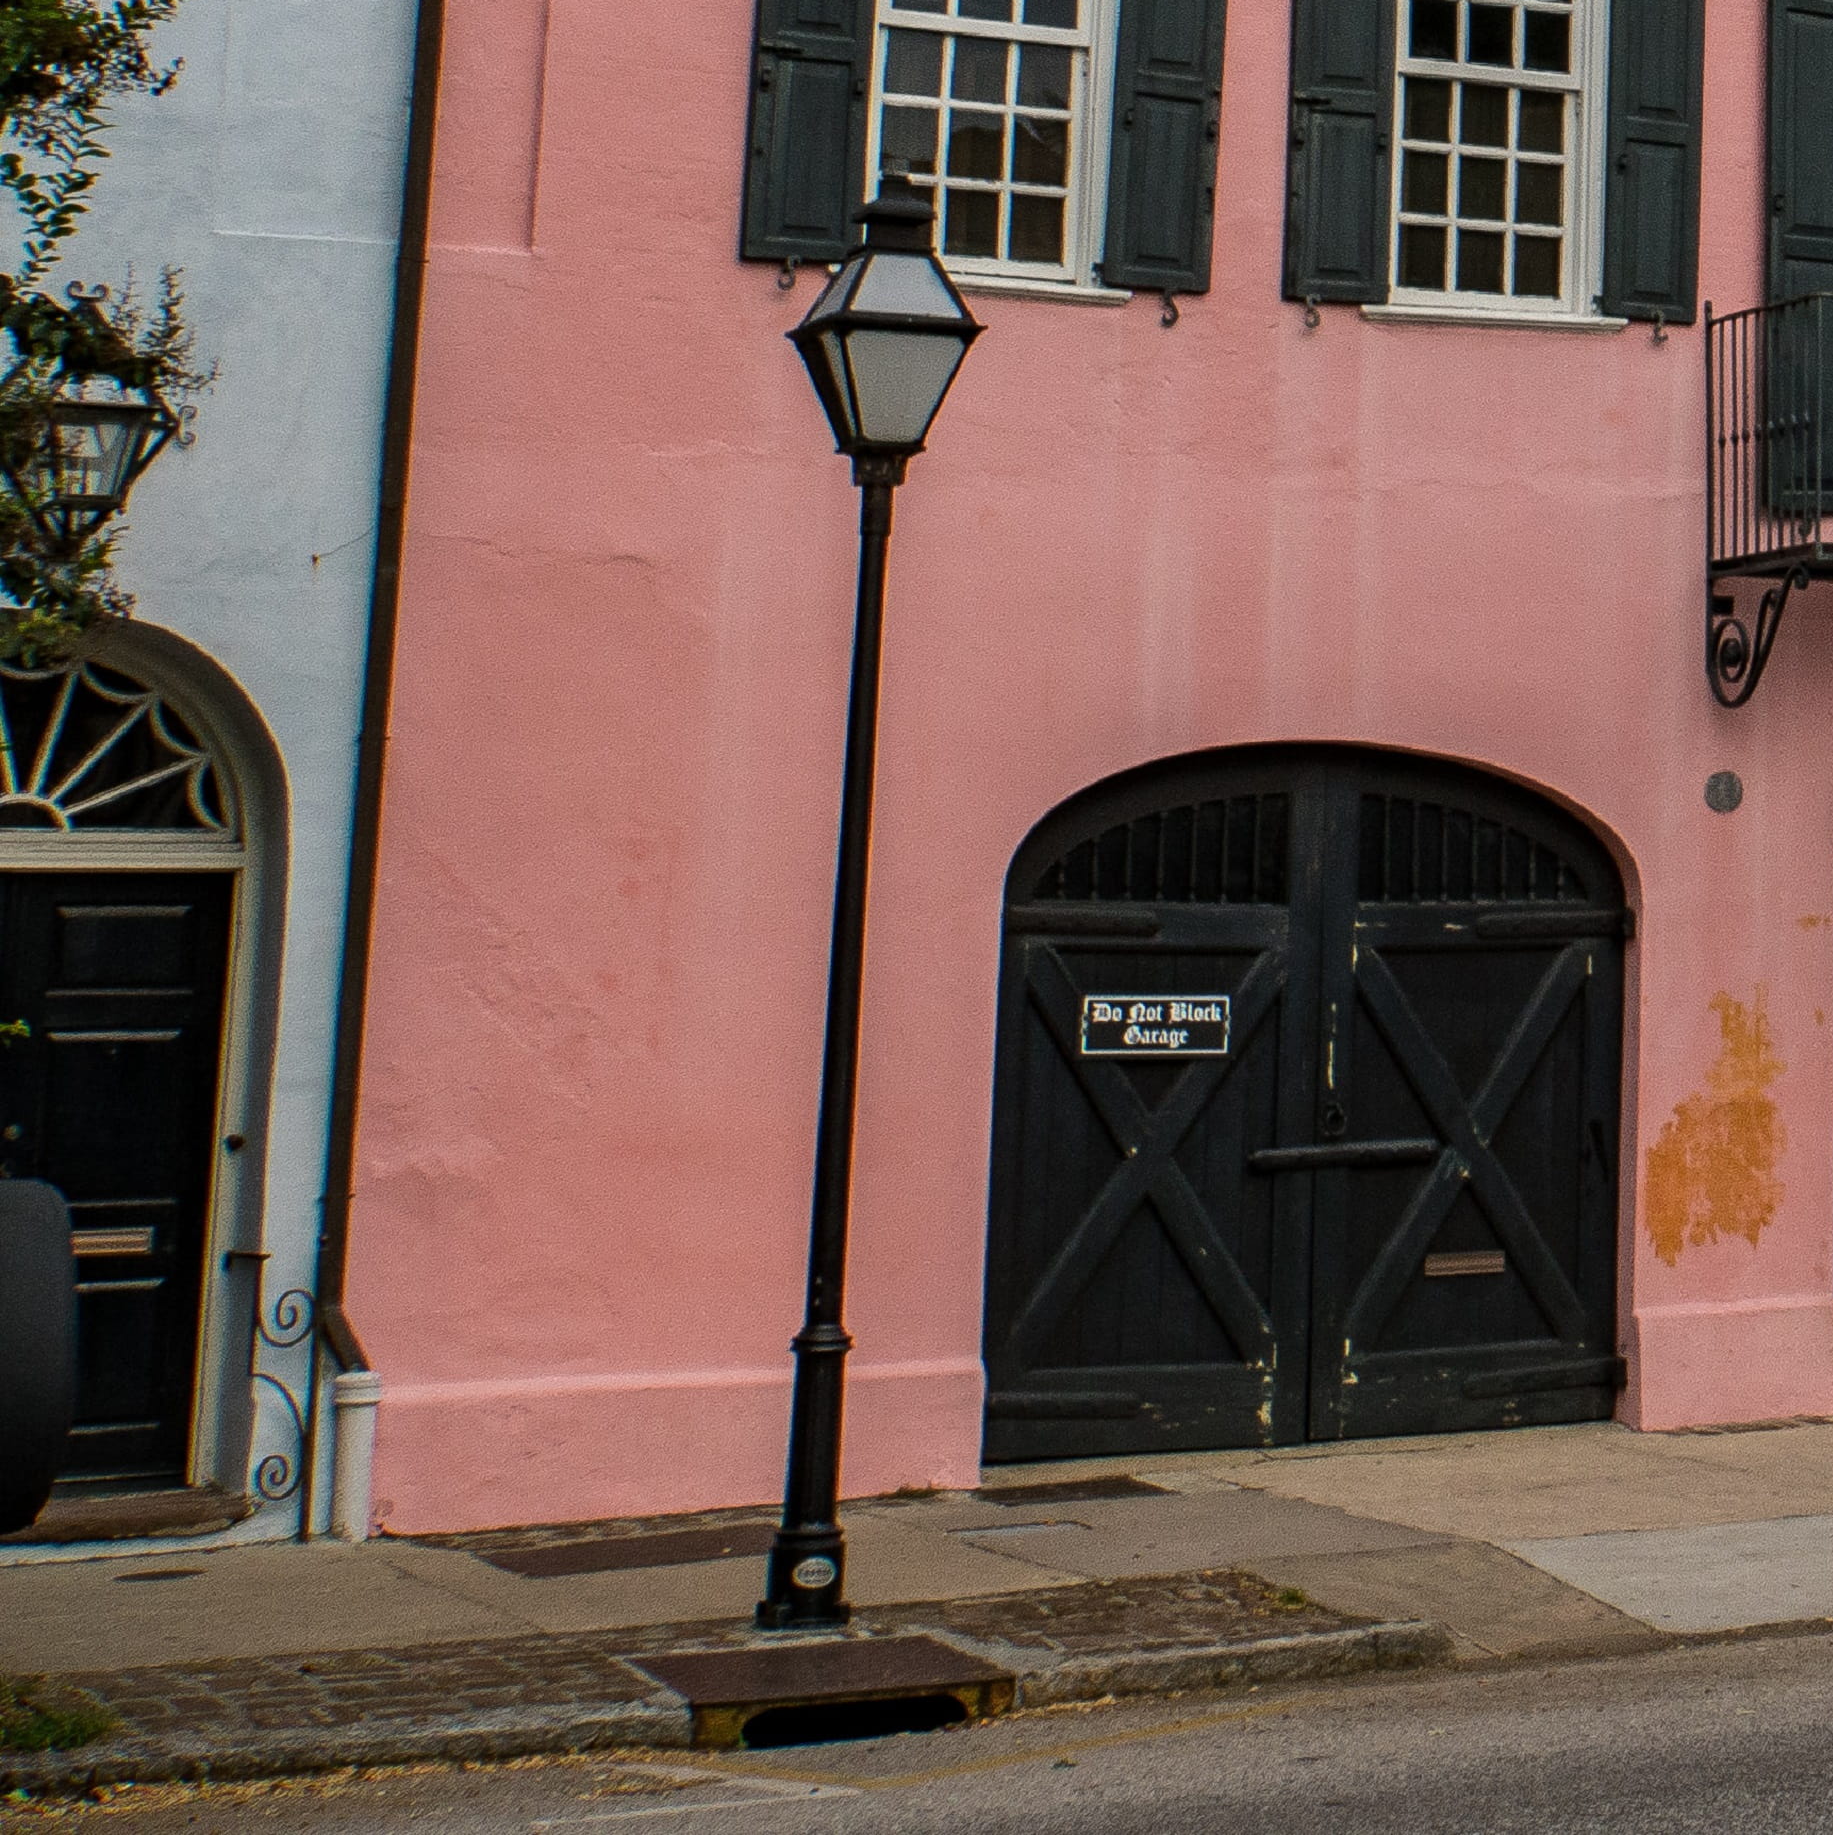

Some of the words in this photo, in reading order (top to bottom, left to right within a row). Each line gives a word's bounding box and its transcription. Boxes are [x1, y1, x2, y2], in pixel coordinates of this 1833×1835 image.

[1092, 1002, 1122, 1023] Do
[1126, 1002, 1163, 1024] Not
[1169, 1002, 1221, 1024] Block
[1124, 1025, 1189, 1048] Garage
